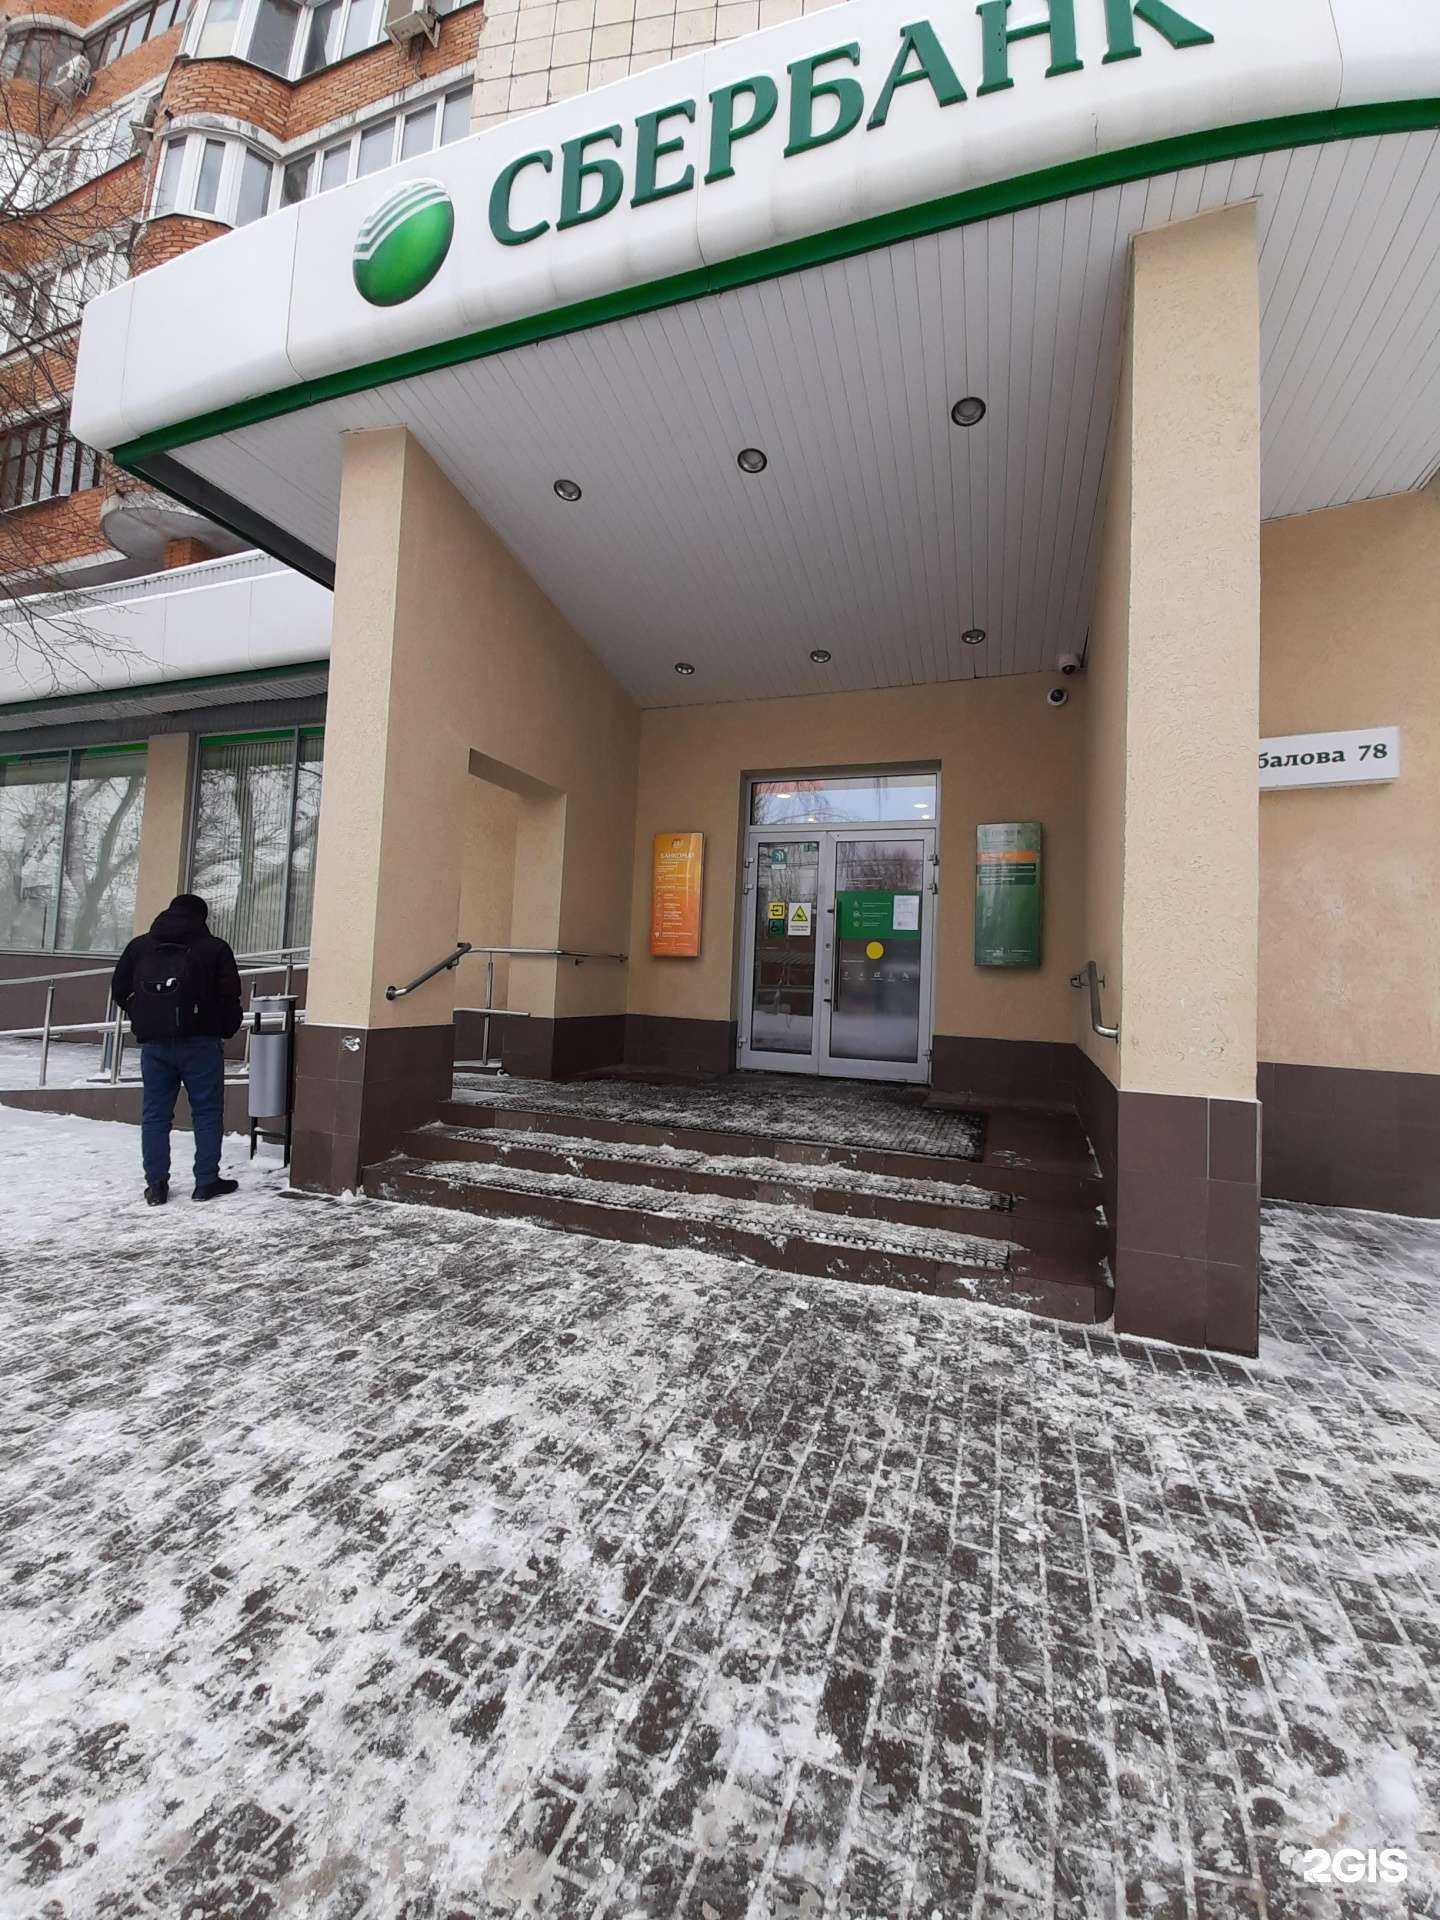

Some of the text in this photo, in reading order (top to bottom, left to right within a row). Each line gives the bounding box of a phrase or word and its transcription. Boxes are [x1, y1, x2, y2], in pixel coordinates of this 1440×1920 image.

[489, 0, 1214, 246] СБЕРБАНК
[1258, 743, 1388, 769] балова 78
